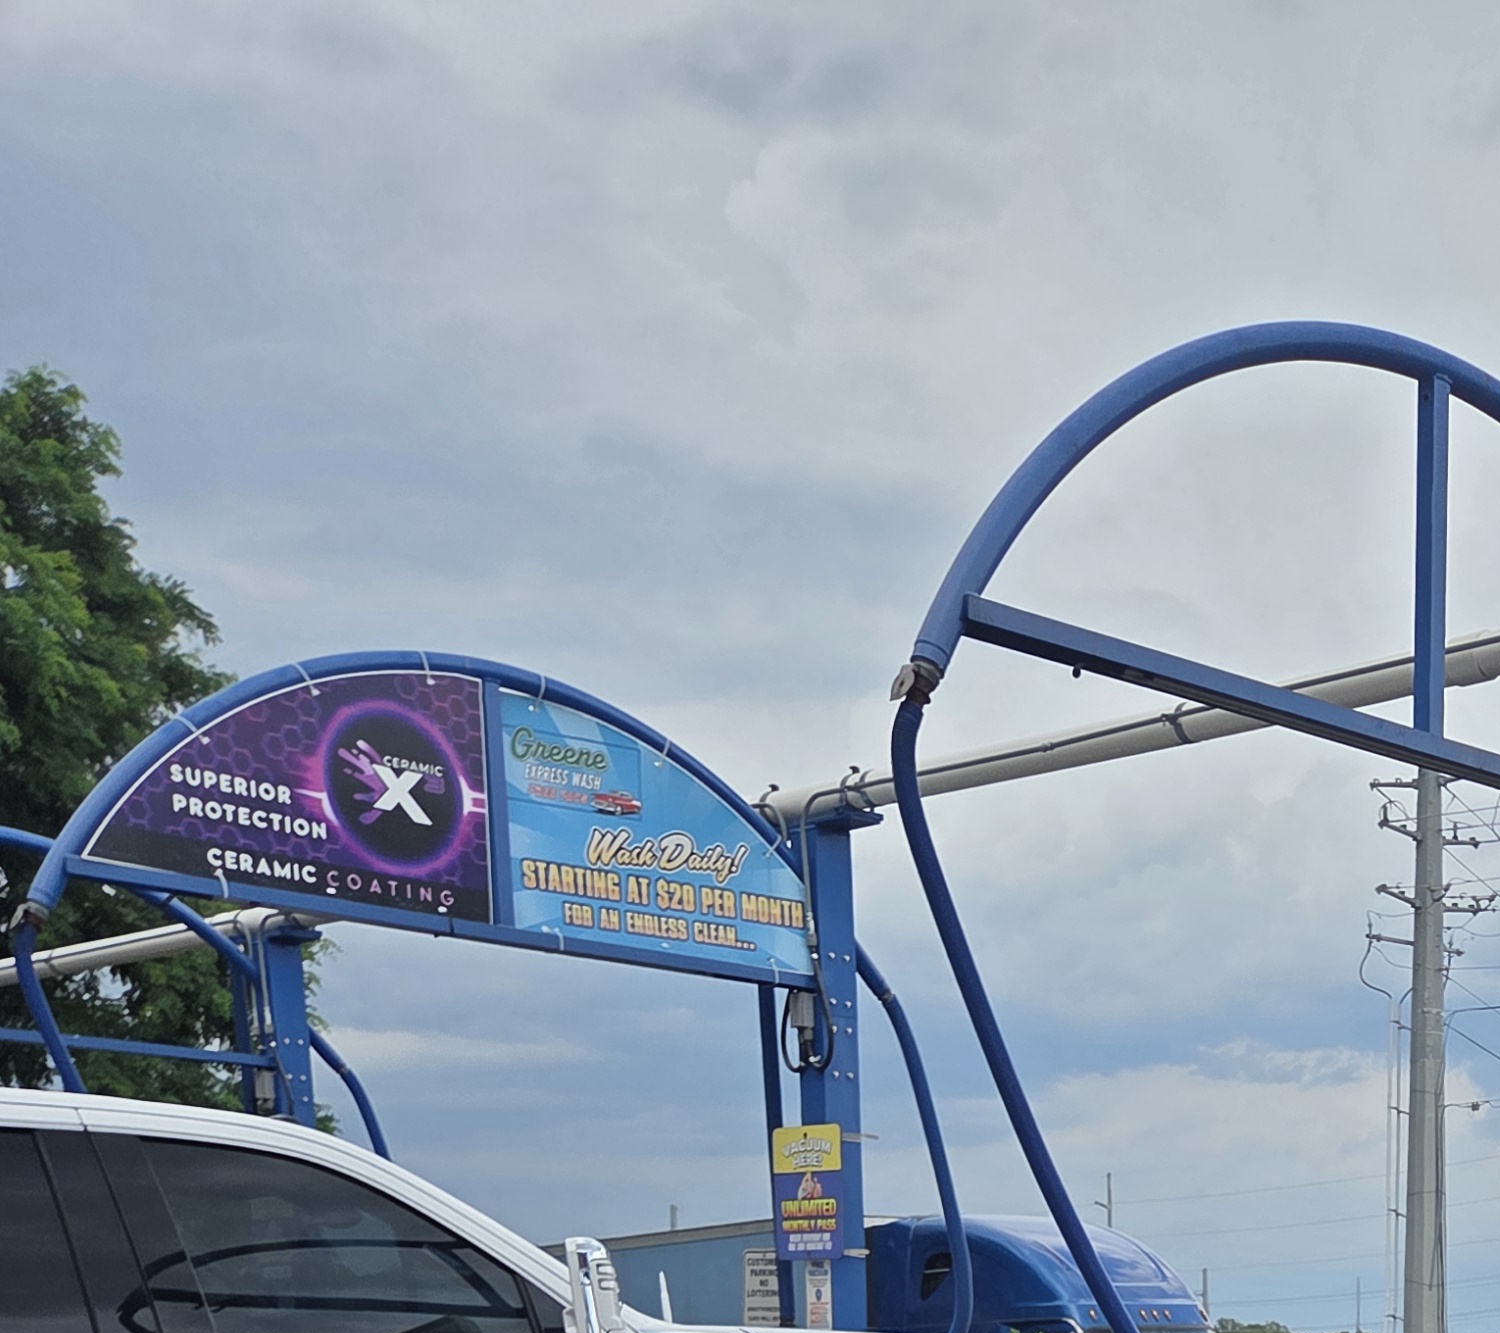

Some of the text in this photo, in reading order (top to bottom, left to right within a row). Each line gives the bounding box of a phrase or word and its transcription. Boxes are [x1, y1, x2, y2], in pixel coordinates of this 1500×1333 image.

[383, 755, 444, 778] CERAMIC
[511, 726, 608, 771] Greene
[170, 764, 292, 805] SUPERIOR
[372, 763, 433, 826] X
[525, 764, 601, 790] EXPRESS WASH
[172, 793, 327, 839] PROTECTION
[206, 848, 454, 906] CERAMIC COATING
[587, 828, 747, 885] Wash Daily!
[522, 859, 805, 928] STARTING AT $20 PER MONTH
[564, 902, 756, 950] FOR AN ENDLESS CLEAN...
[782, 1138, 832, 1158] VACUUM
[781, 1198, 836, 1218] UNLIMITED
